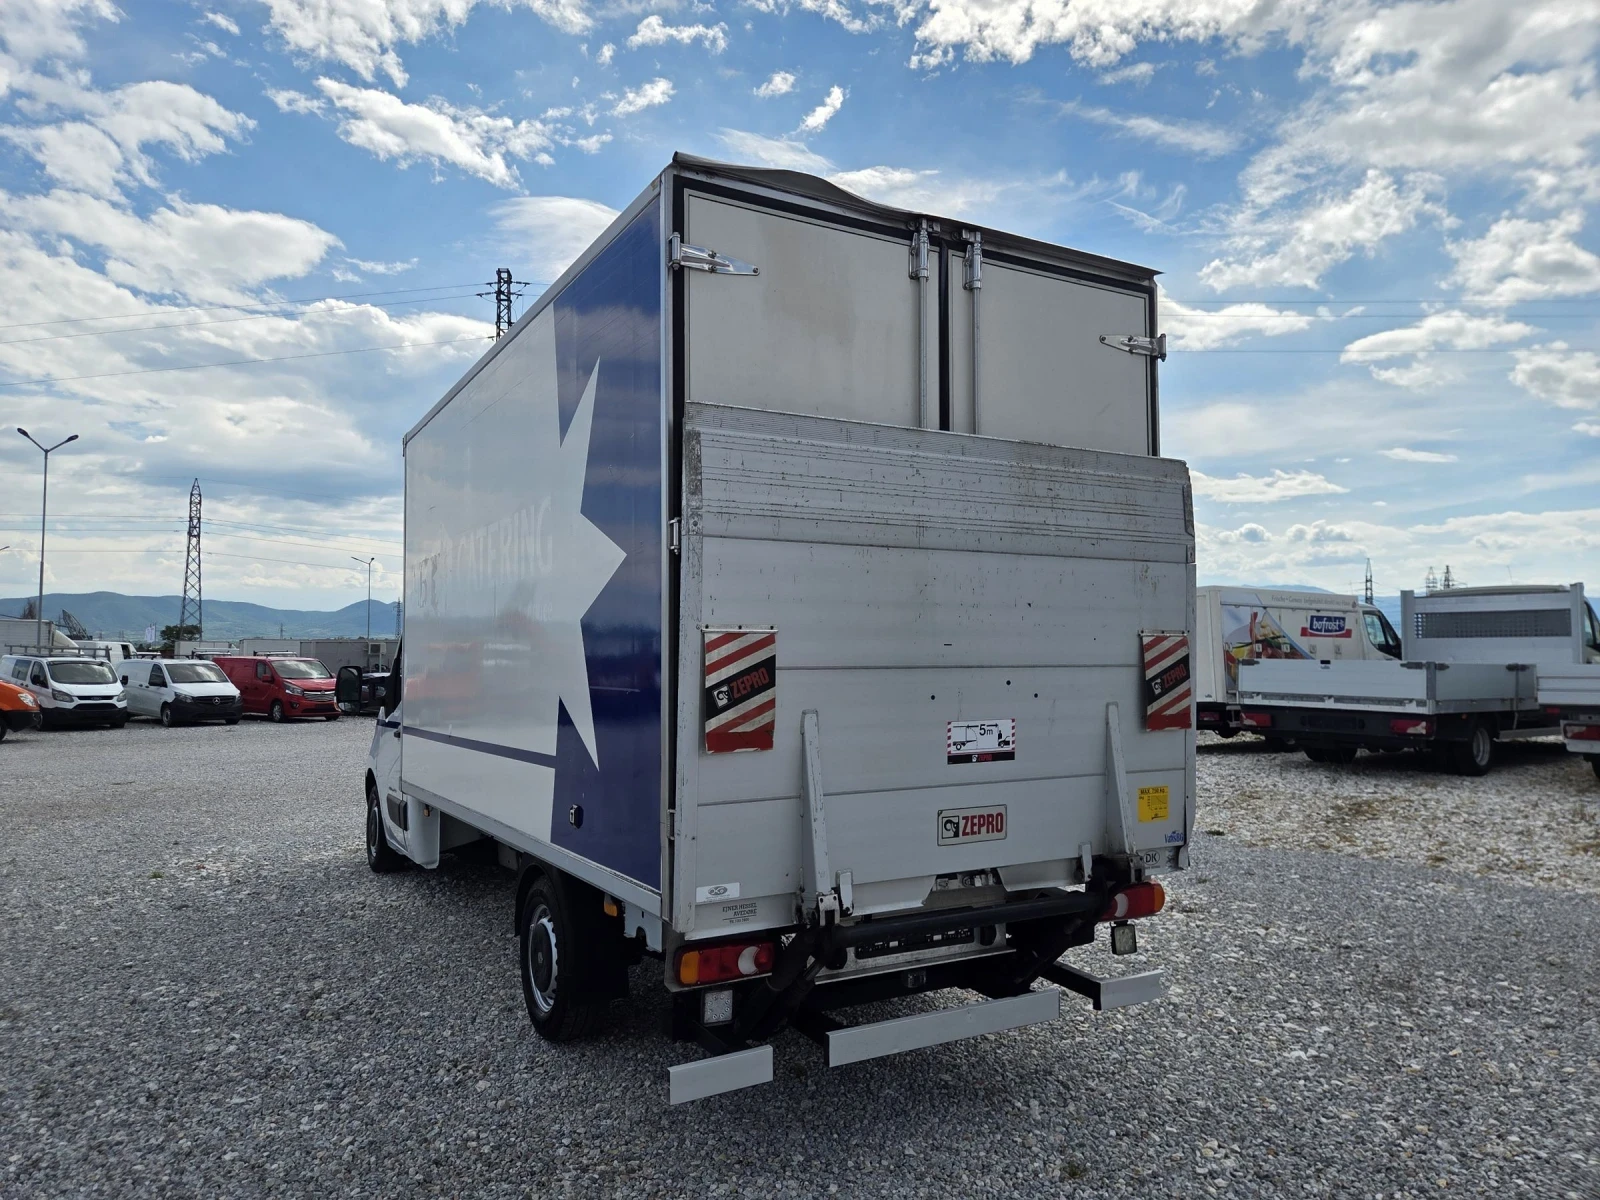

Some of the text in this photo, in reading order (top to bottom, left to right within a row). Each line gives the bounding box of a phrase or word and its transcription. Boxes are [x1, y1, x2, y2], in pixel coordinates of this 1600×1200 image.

[1312, 617, 1339, 634] bofrost
[730, 667, 770, 699] ZEPRO
[1161, 663, 1187, 689] ZEPRO
[961, 812, 1004, 837] ZEPRO
[1145, 853, 1157, 862] DK
